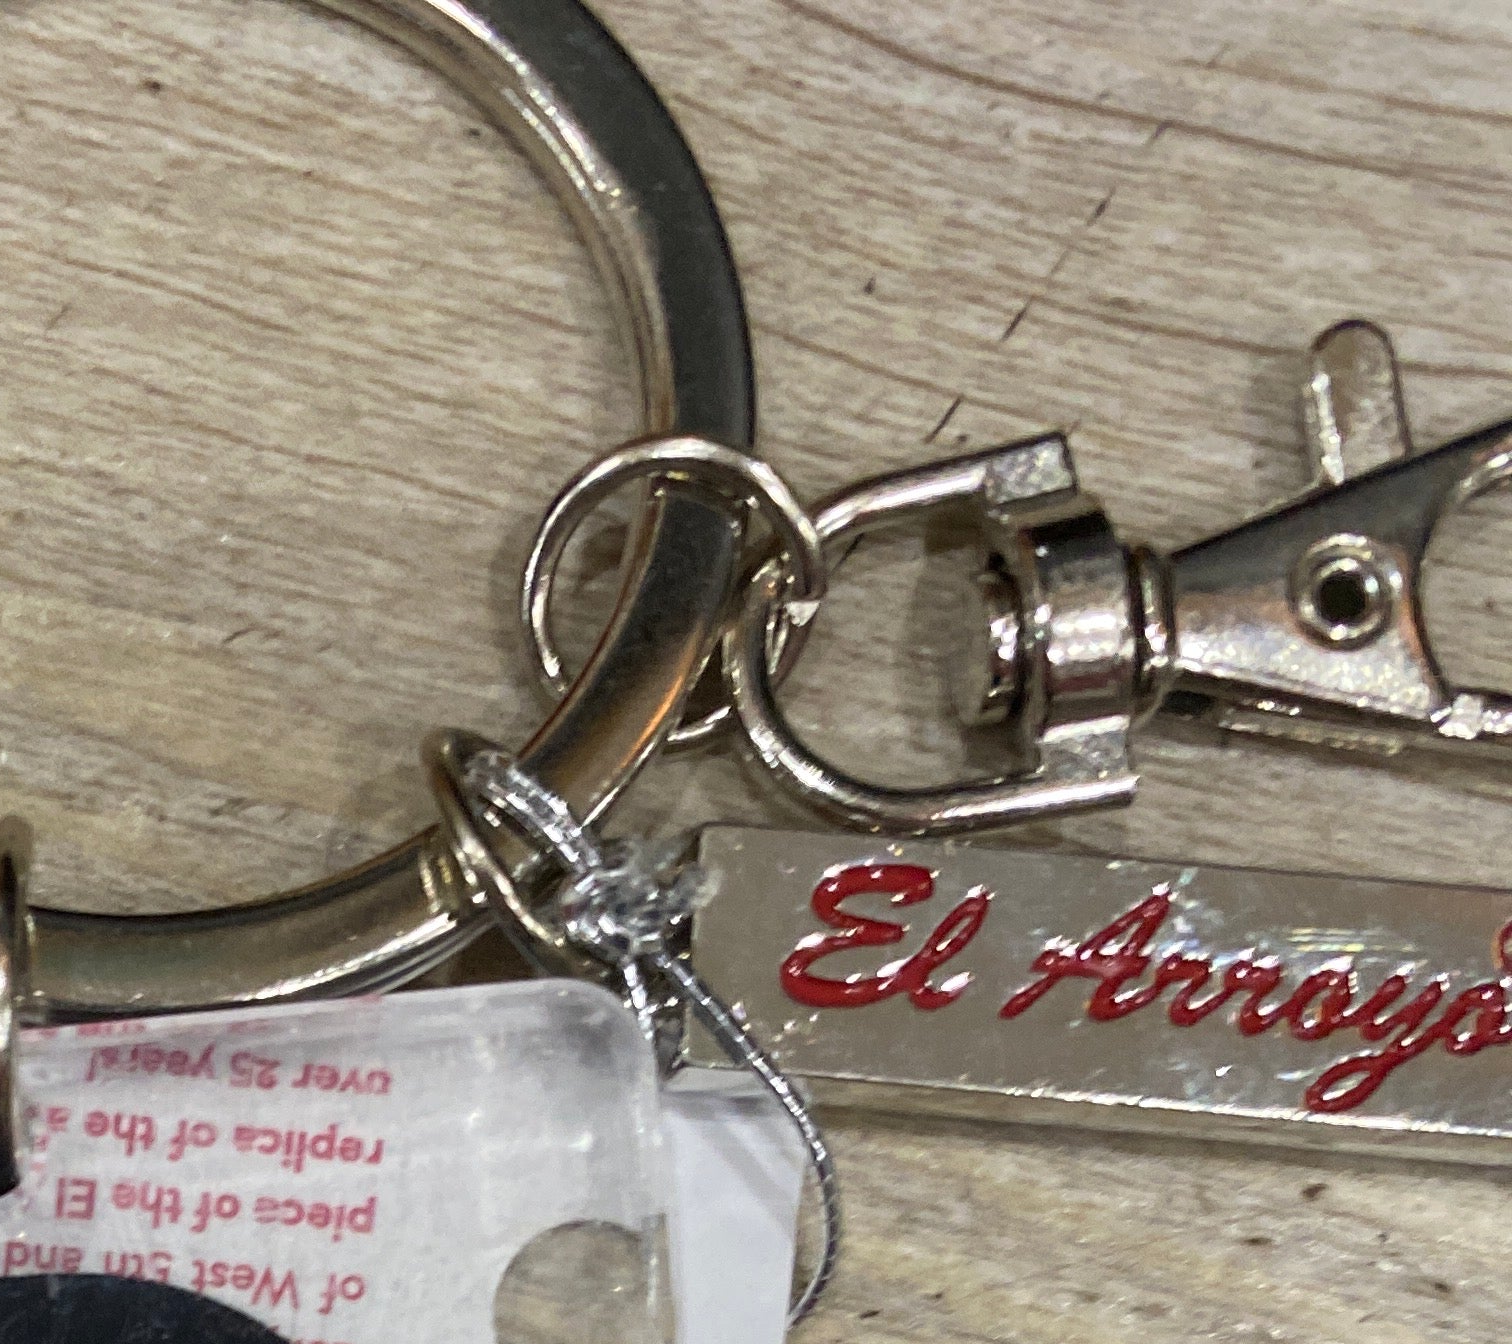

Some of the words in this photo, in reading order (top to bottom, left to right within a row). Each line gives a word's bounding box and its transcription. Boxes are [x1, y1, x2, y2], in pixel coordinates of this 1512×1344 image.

[780, 860, 990, 1011] El
[998, 880, 1512, 1114] Arroyo
[83, 1111, 157, 1158] the
[167, 1119, 218, 1164] of
[231, 1123, 384, 1176] replica
[55, 1177, 98, 1222] El
[110, 1182, 183, 1231] the
[189, 1190, 241, 1235] of
[3, 1240, 84, 1277] and
[188, 1260, 300, 1311] West
[318, 1272, 366, 1315] of
